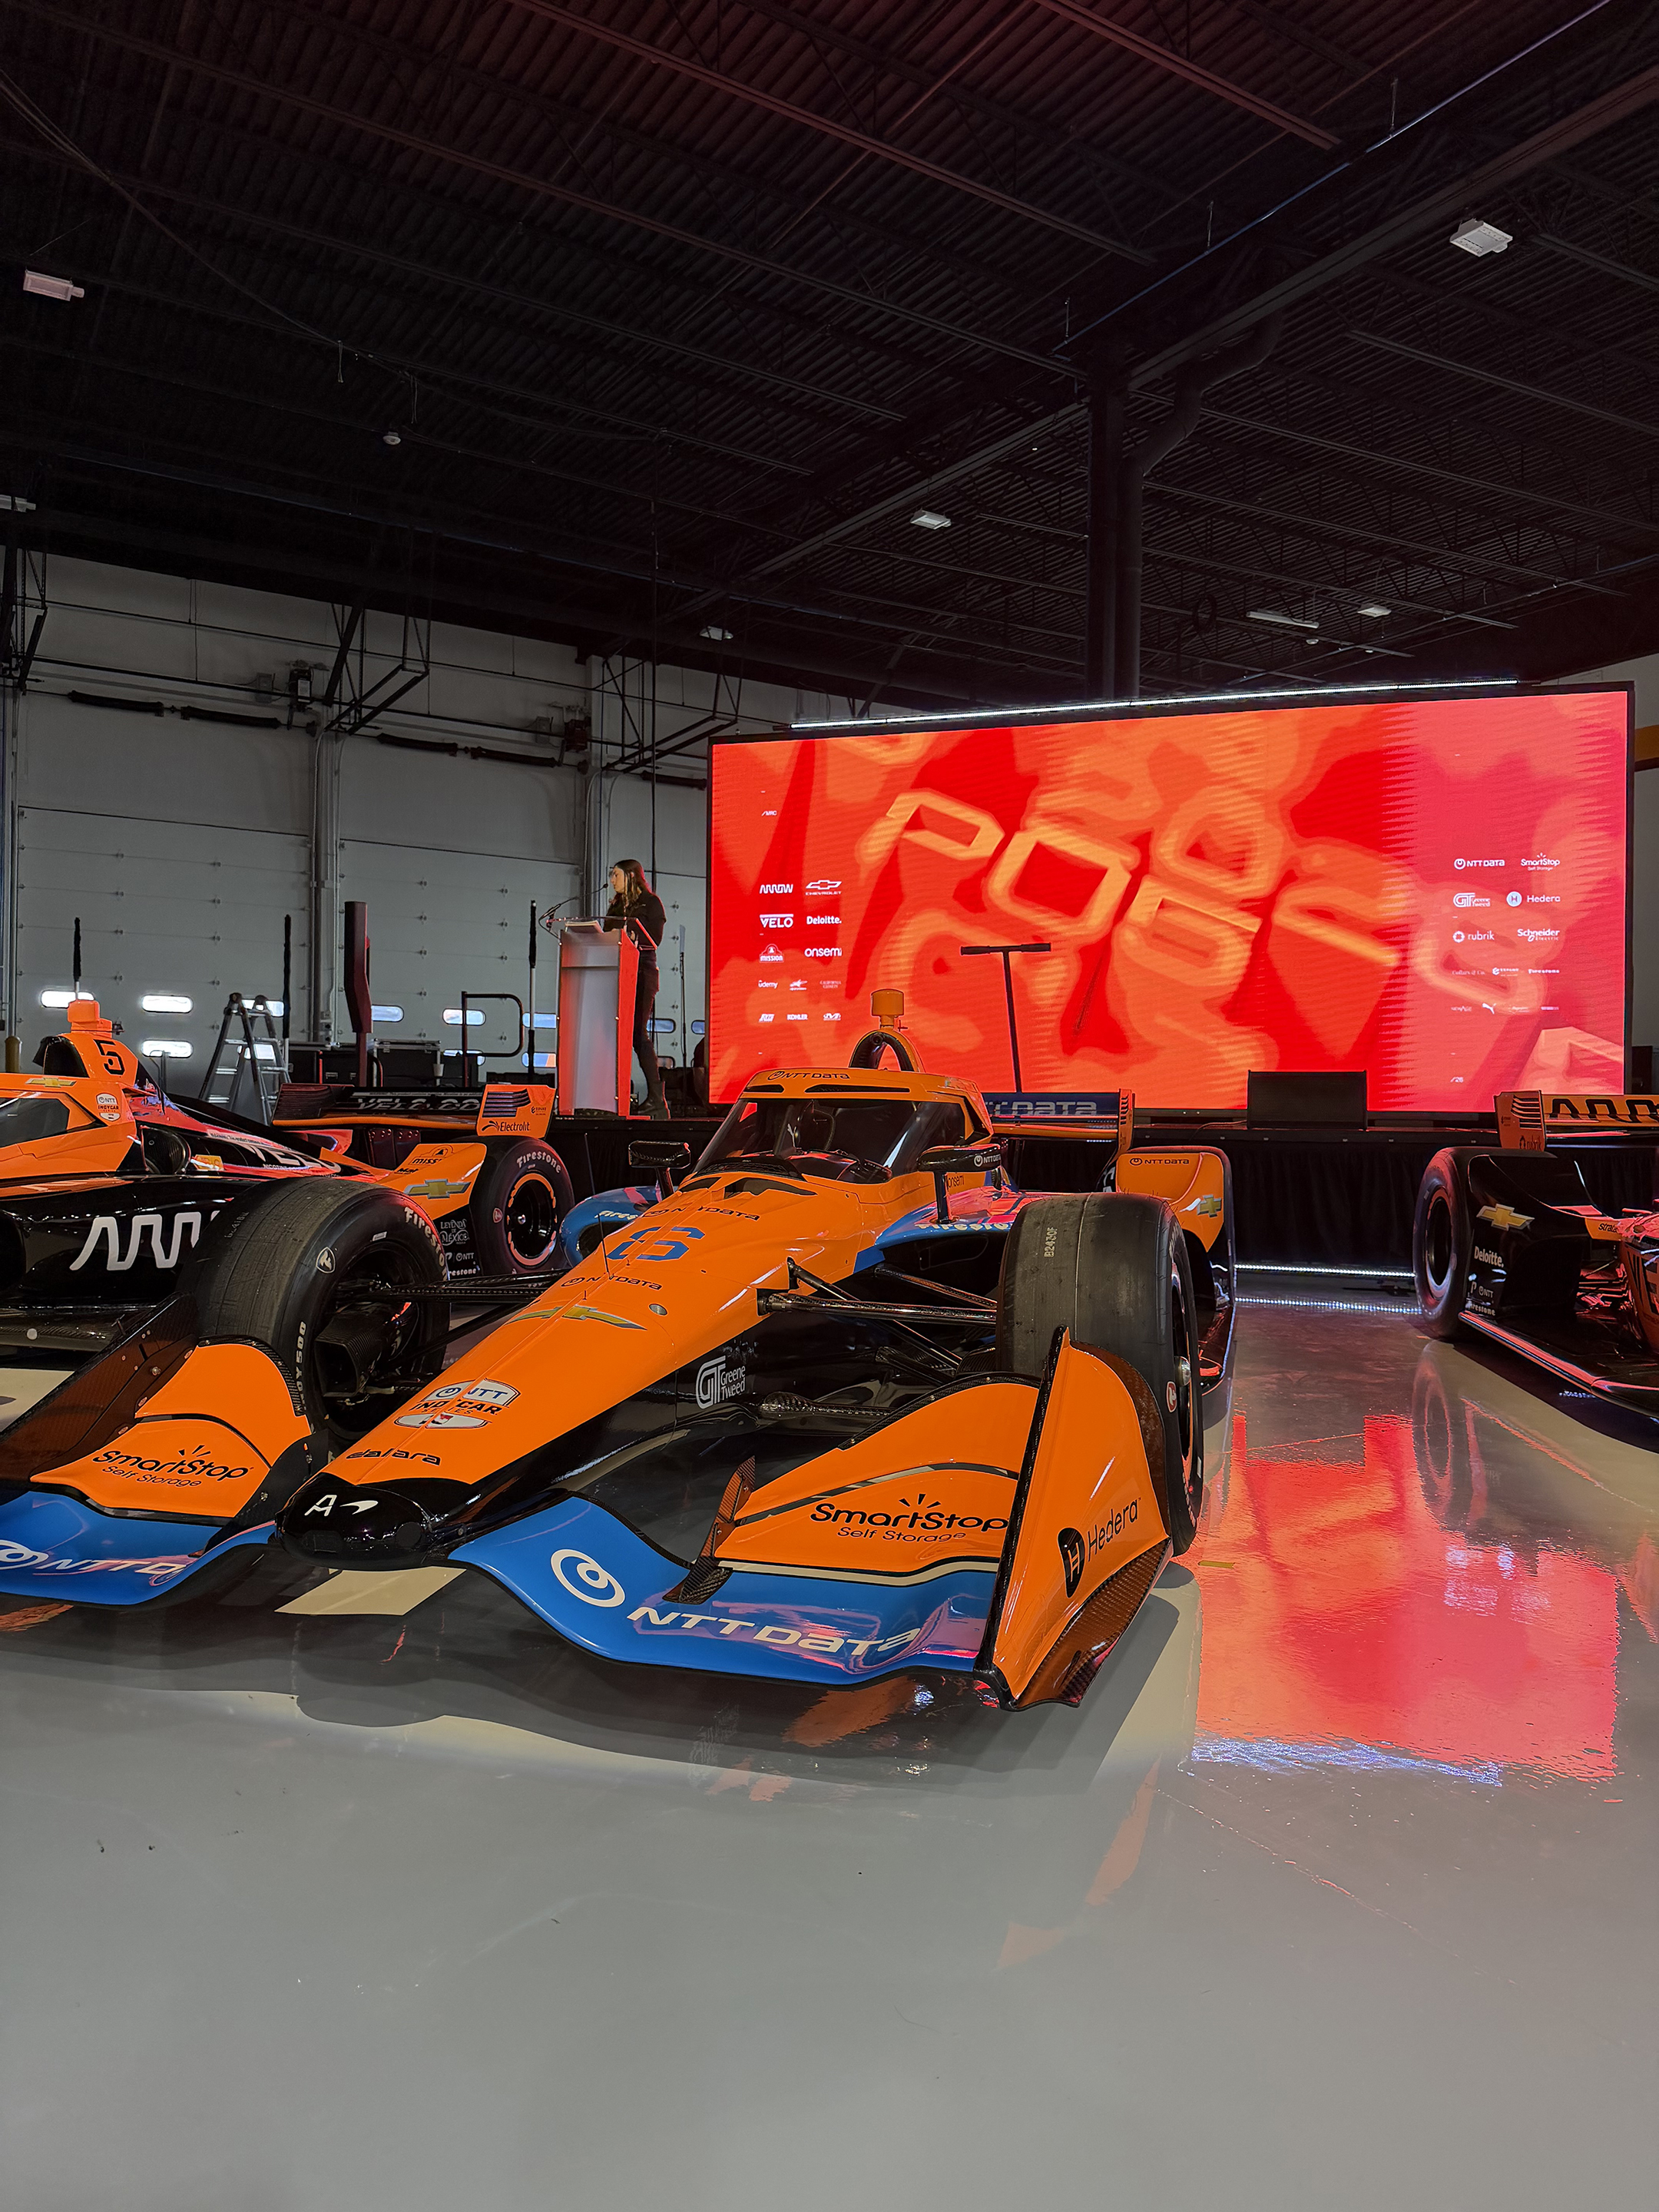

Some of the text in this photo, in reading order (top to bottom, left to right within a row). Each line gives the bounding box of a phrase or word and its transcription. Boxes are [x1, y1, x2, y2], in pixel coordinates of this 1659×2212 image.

[1520, 858, 1561, 866] SmartStop
[1526, 894, 1561, 903] Hedera
[760, 916, 794, 929] VELO
[806, 916, 843, 925] Deloitte.
[1467, 930, 1495, 941] rubrik
[1516, 928, 1561, 937] Schneider
[803, 947, 843, 958] onsemi
[93, 1038, 126, 1075] 5
[499, 1121, 530, 1132] Electrolit
[515, 1151, 562, 1174] Firestone
[983, 1155, 993, 1164] NTT
[1473, 1245, 1505, 1269] Deloitte.
[295, 1320, 306, 1364] 500
[720, 1365, 746, 1386] Greene
[720, 1376, 746, 1401] Tweed
[408, 1400, 503, 1416] INDCAR
[422, 1407, 473, 1416] SEIES
[92, 1450, 247, 1482] SmartStop
[102, 1465, 203, 1488] Self Storage
[810, 1502, 1008, 1532] SmartStop
[836, 1526, 967, 1543] Self Storage
[1087, 1498, 1138, 1562] Hedera
[35, 1558, 152, 1572] NTT
[626, 1607, 922, 1657] NTT DATA
